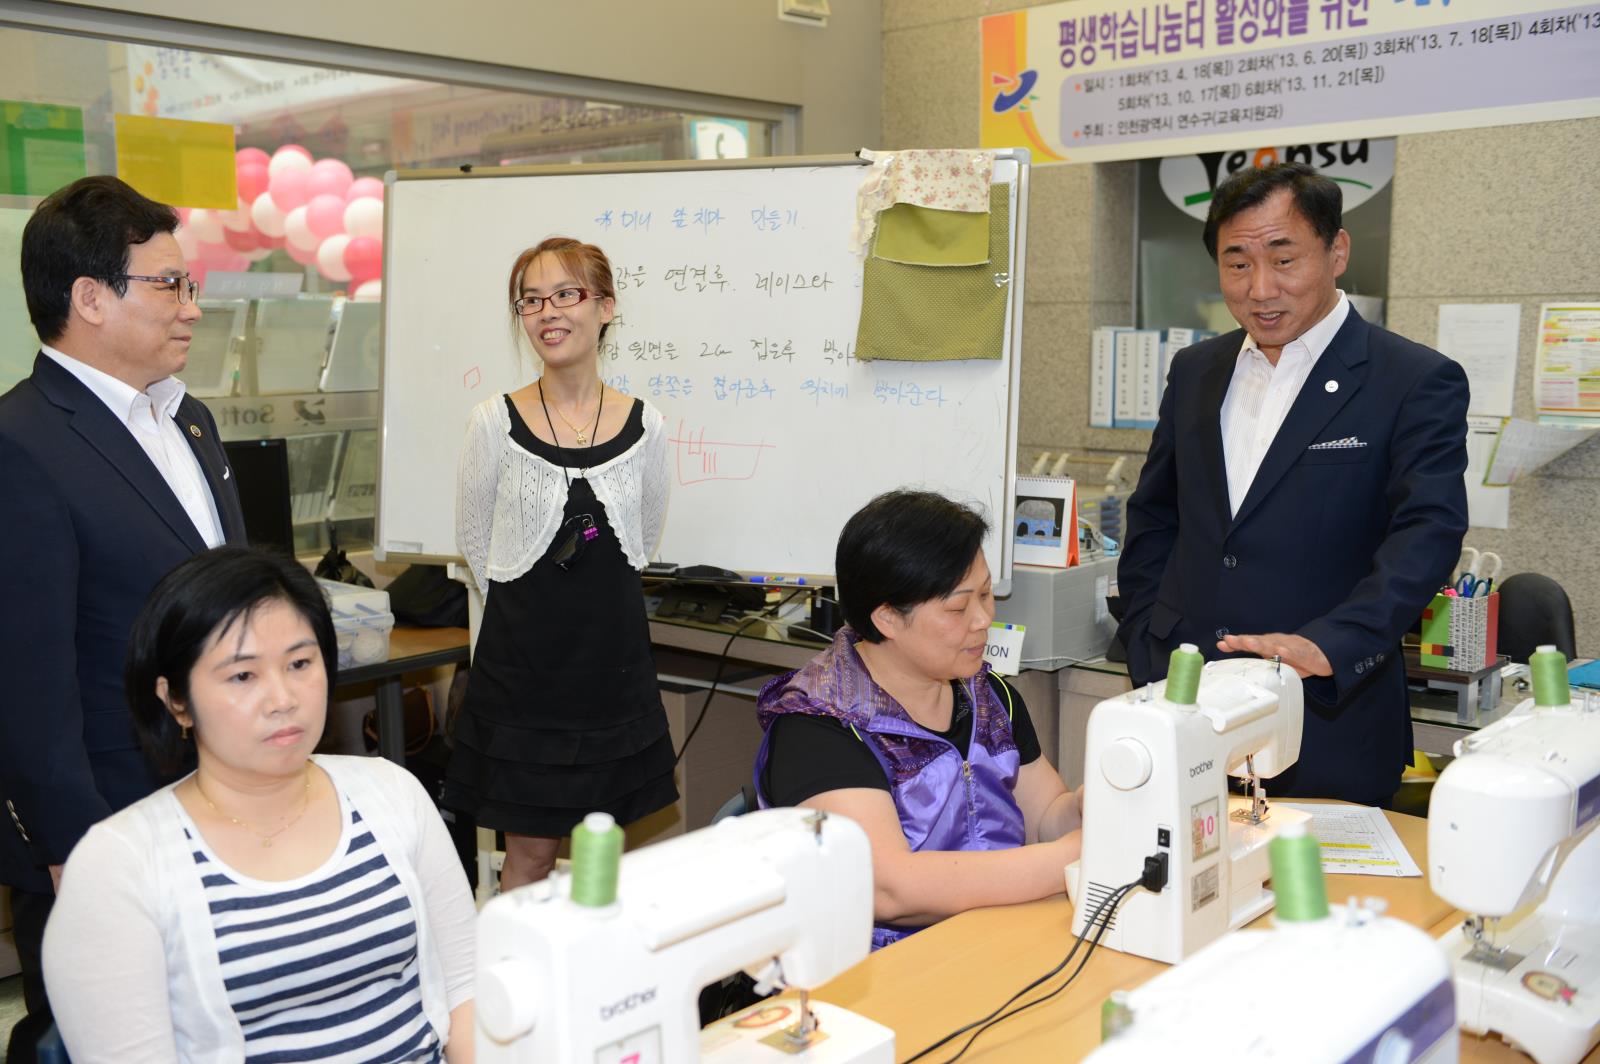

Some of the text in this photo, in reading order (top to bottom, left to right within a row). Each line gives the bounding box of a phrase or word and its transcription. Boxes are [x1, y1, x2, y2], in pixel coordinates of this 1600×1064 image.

[1058, 0, 1205, 68] 평생학습나눔터
[1083, 77, 1105, 93] 일시
[1176, 67, 1188, 80] 4.
[1193, 59, 1234, 79] 18[목])
[1303, 50, 1316, 65] 6.
[1322, 42, 1368, 63] 20[목])
[1450, 31, 1463, 47] 7.
[1471, 21, 1523, 44] 18[목])
[1178, 89, 1194, 104] 10.
[1201, 82, 1241, 101] 17[목])
[1312, 74, 1332, 89] 11.
[1338, 65, 1385, 87] 21[목])
[1083, 122, 1104, 138] 주최
[1117, 115, 1173, 136] 인천광역시
[1177, 103, 1284, 131] 연수구(교육지원과)
[984, 644, 1009, 658] ION
[1189, 760, 1214, 778] brother
